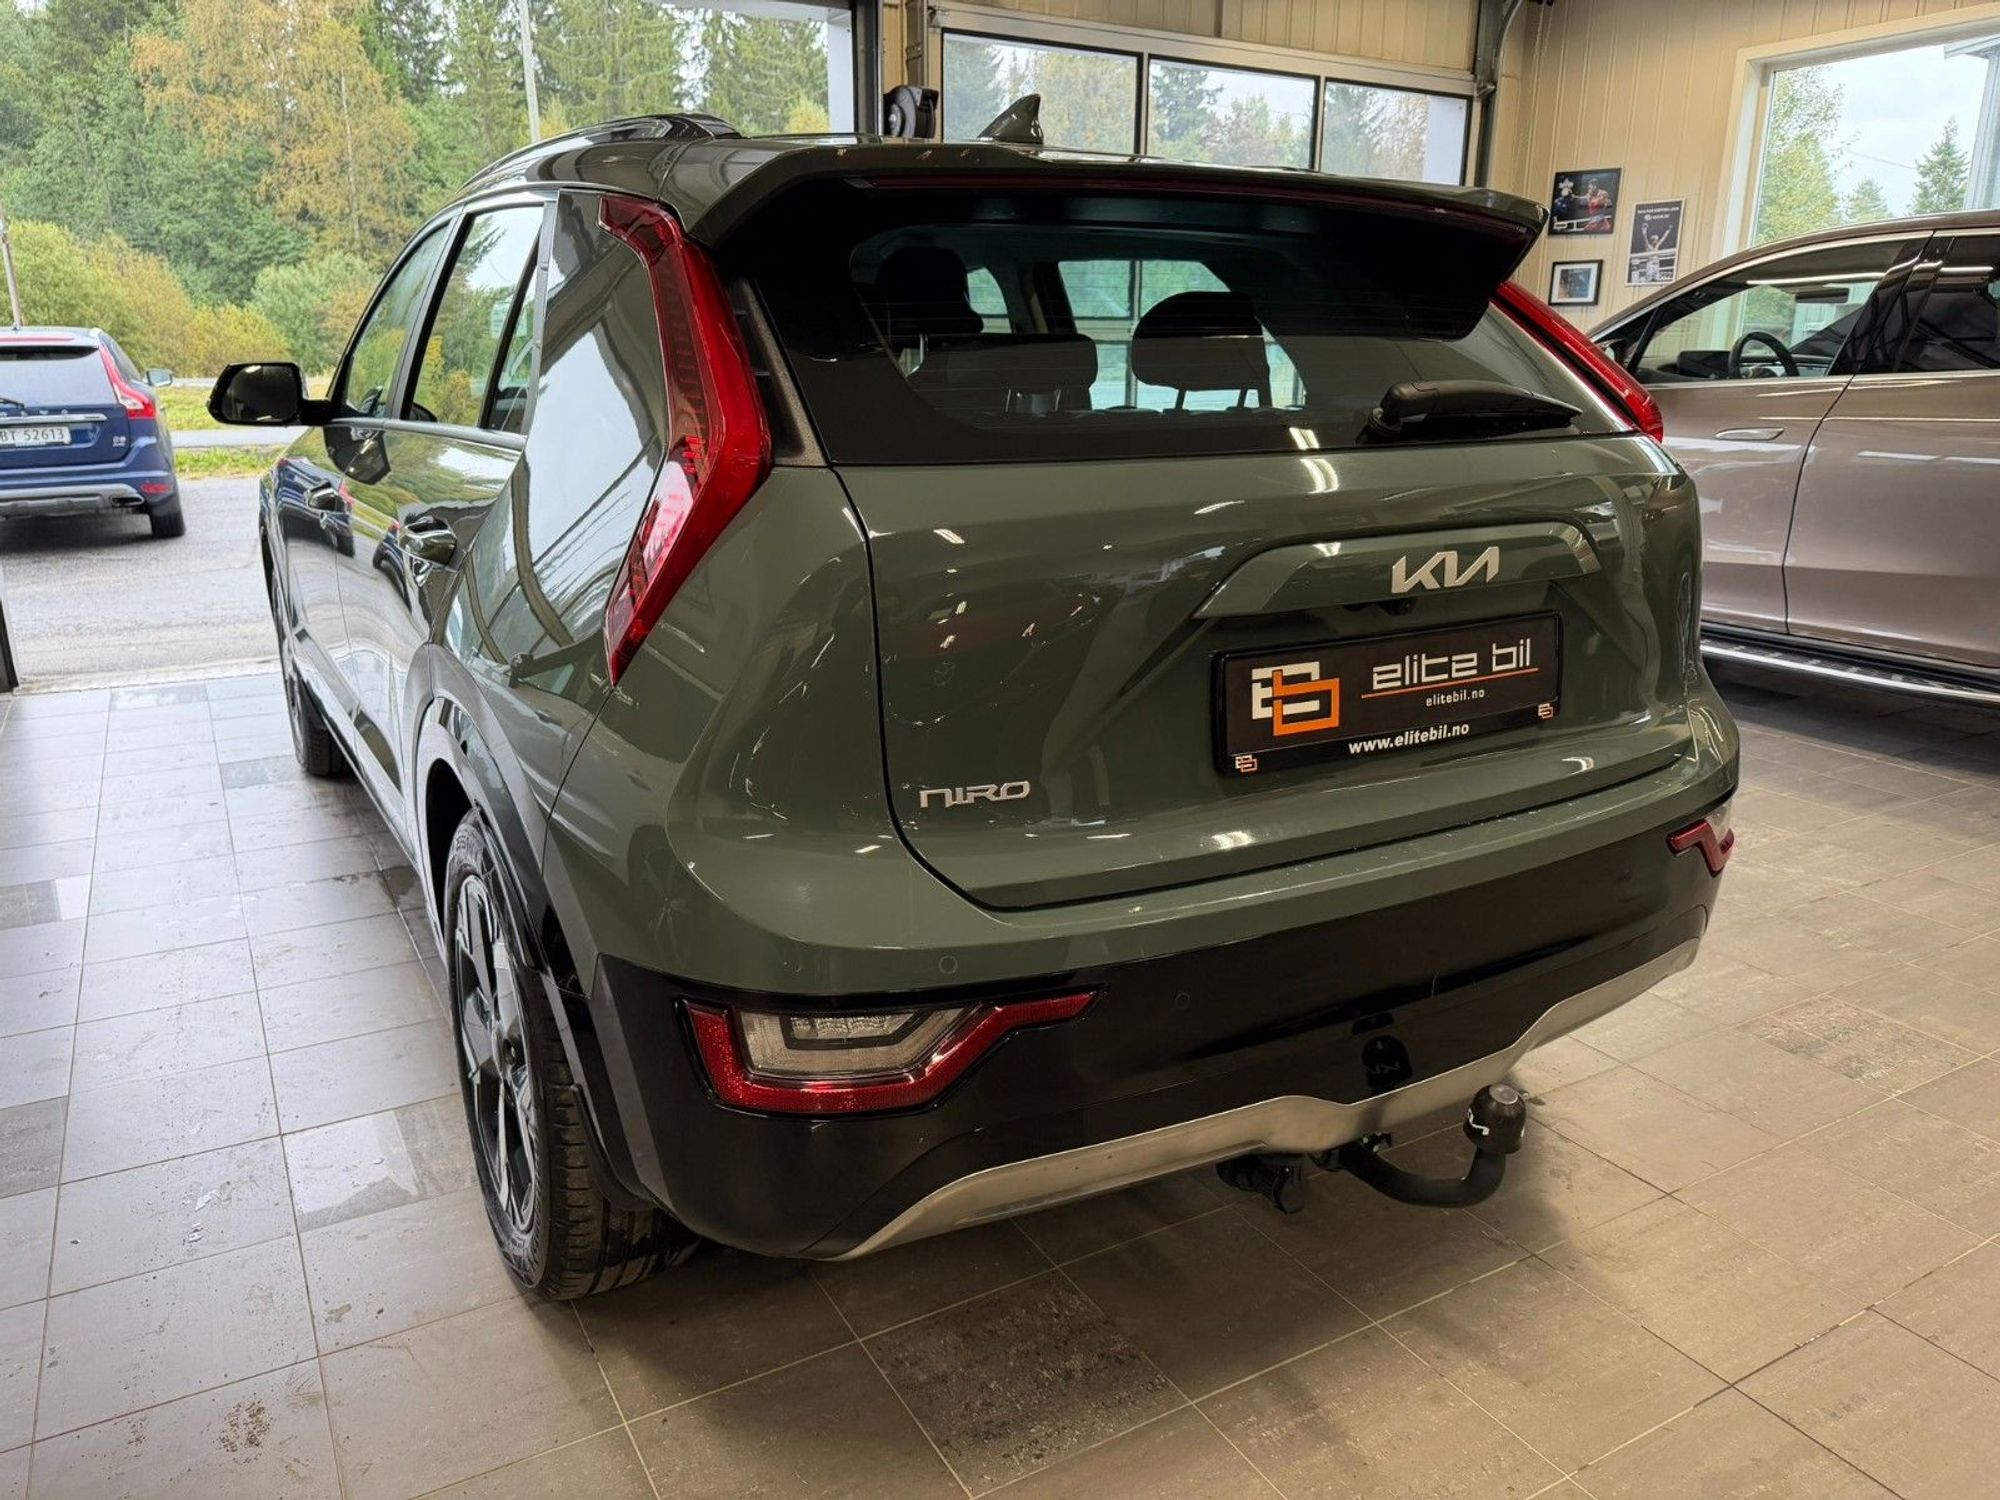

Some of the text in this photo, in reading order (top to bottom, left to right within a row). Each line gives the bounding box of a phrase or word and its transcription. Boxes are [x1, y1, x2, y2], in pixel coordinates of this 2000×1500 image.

[23, 428, 65, 441] 52613
[1391, 546, 1500, 594] KIA
[1372, 637, 1531, 690] elite bil
[1425, 688, 1486, 708] elitebil.no
[1348, 722, 1470, 755] www.elitebil.no
[919, 780, 1031, 808] NIRO
